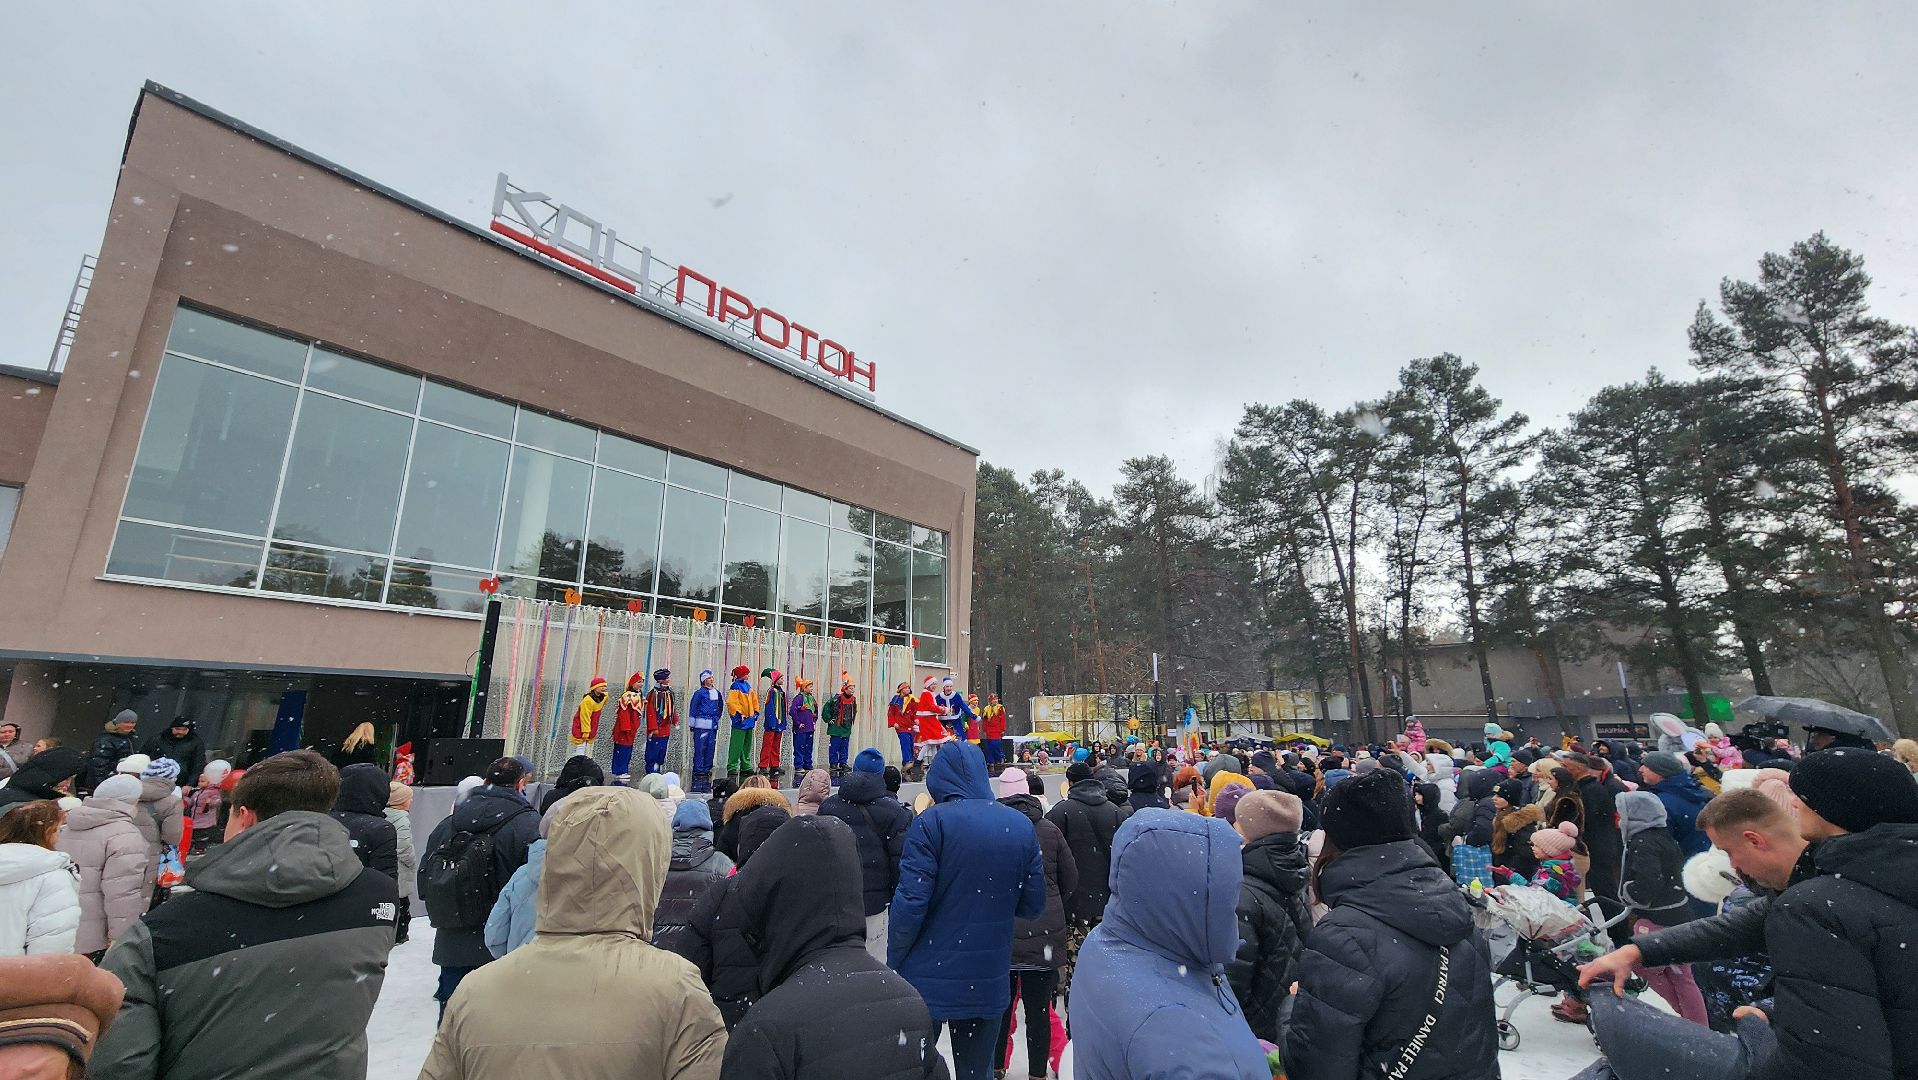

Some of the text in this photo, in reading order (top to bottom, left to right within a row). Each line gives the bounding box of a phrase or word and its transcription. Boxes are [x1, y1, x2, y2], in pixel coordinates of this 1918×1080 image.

[492, 172, 876, 392] КДЦ ПРОТОН
[1434, 954, 1449, 1005] PATRICI
[1402, 1014, 1437, 1065] DANIELE
